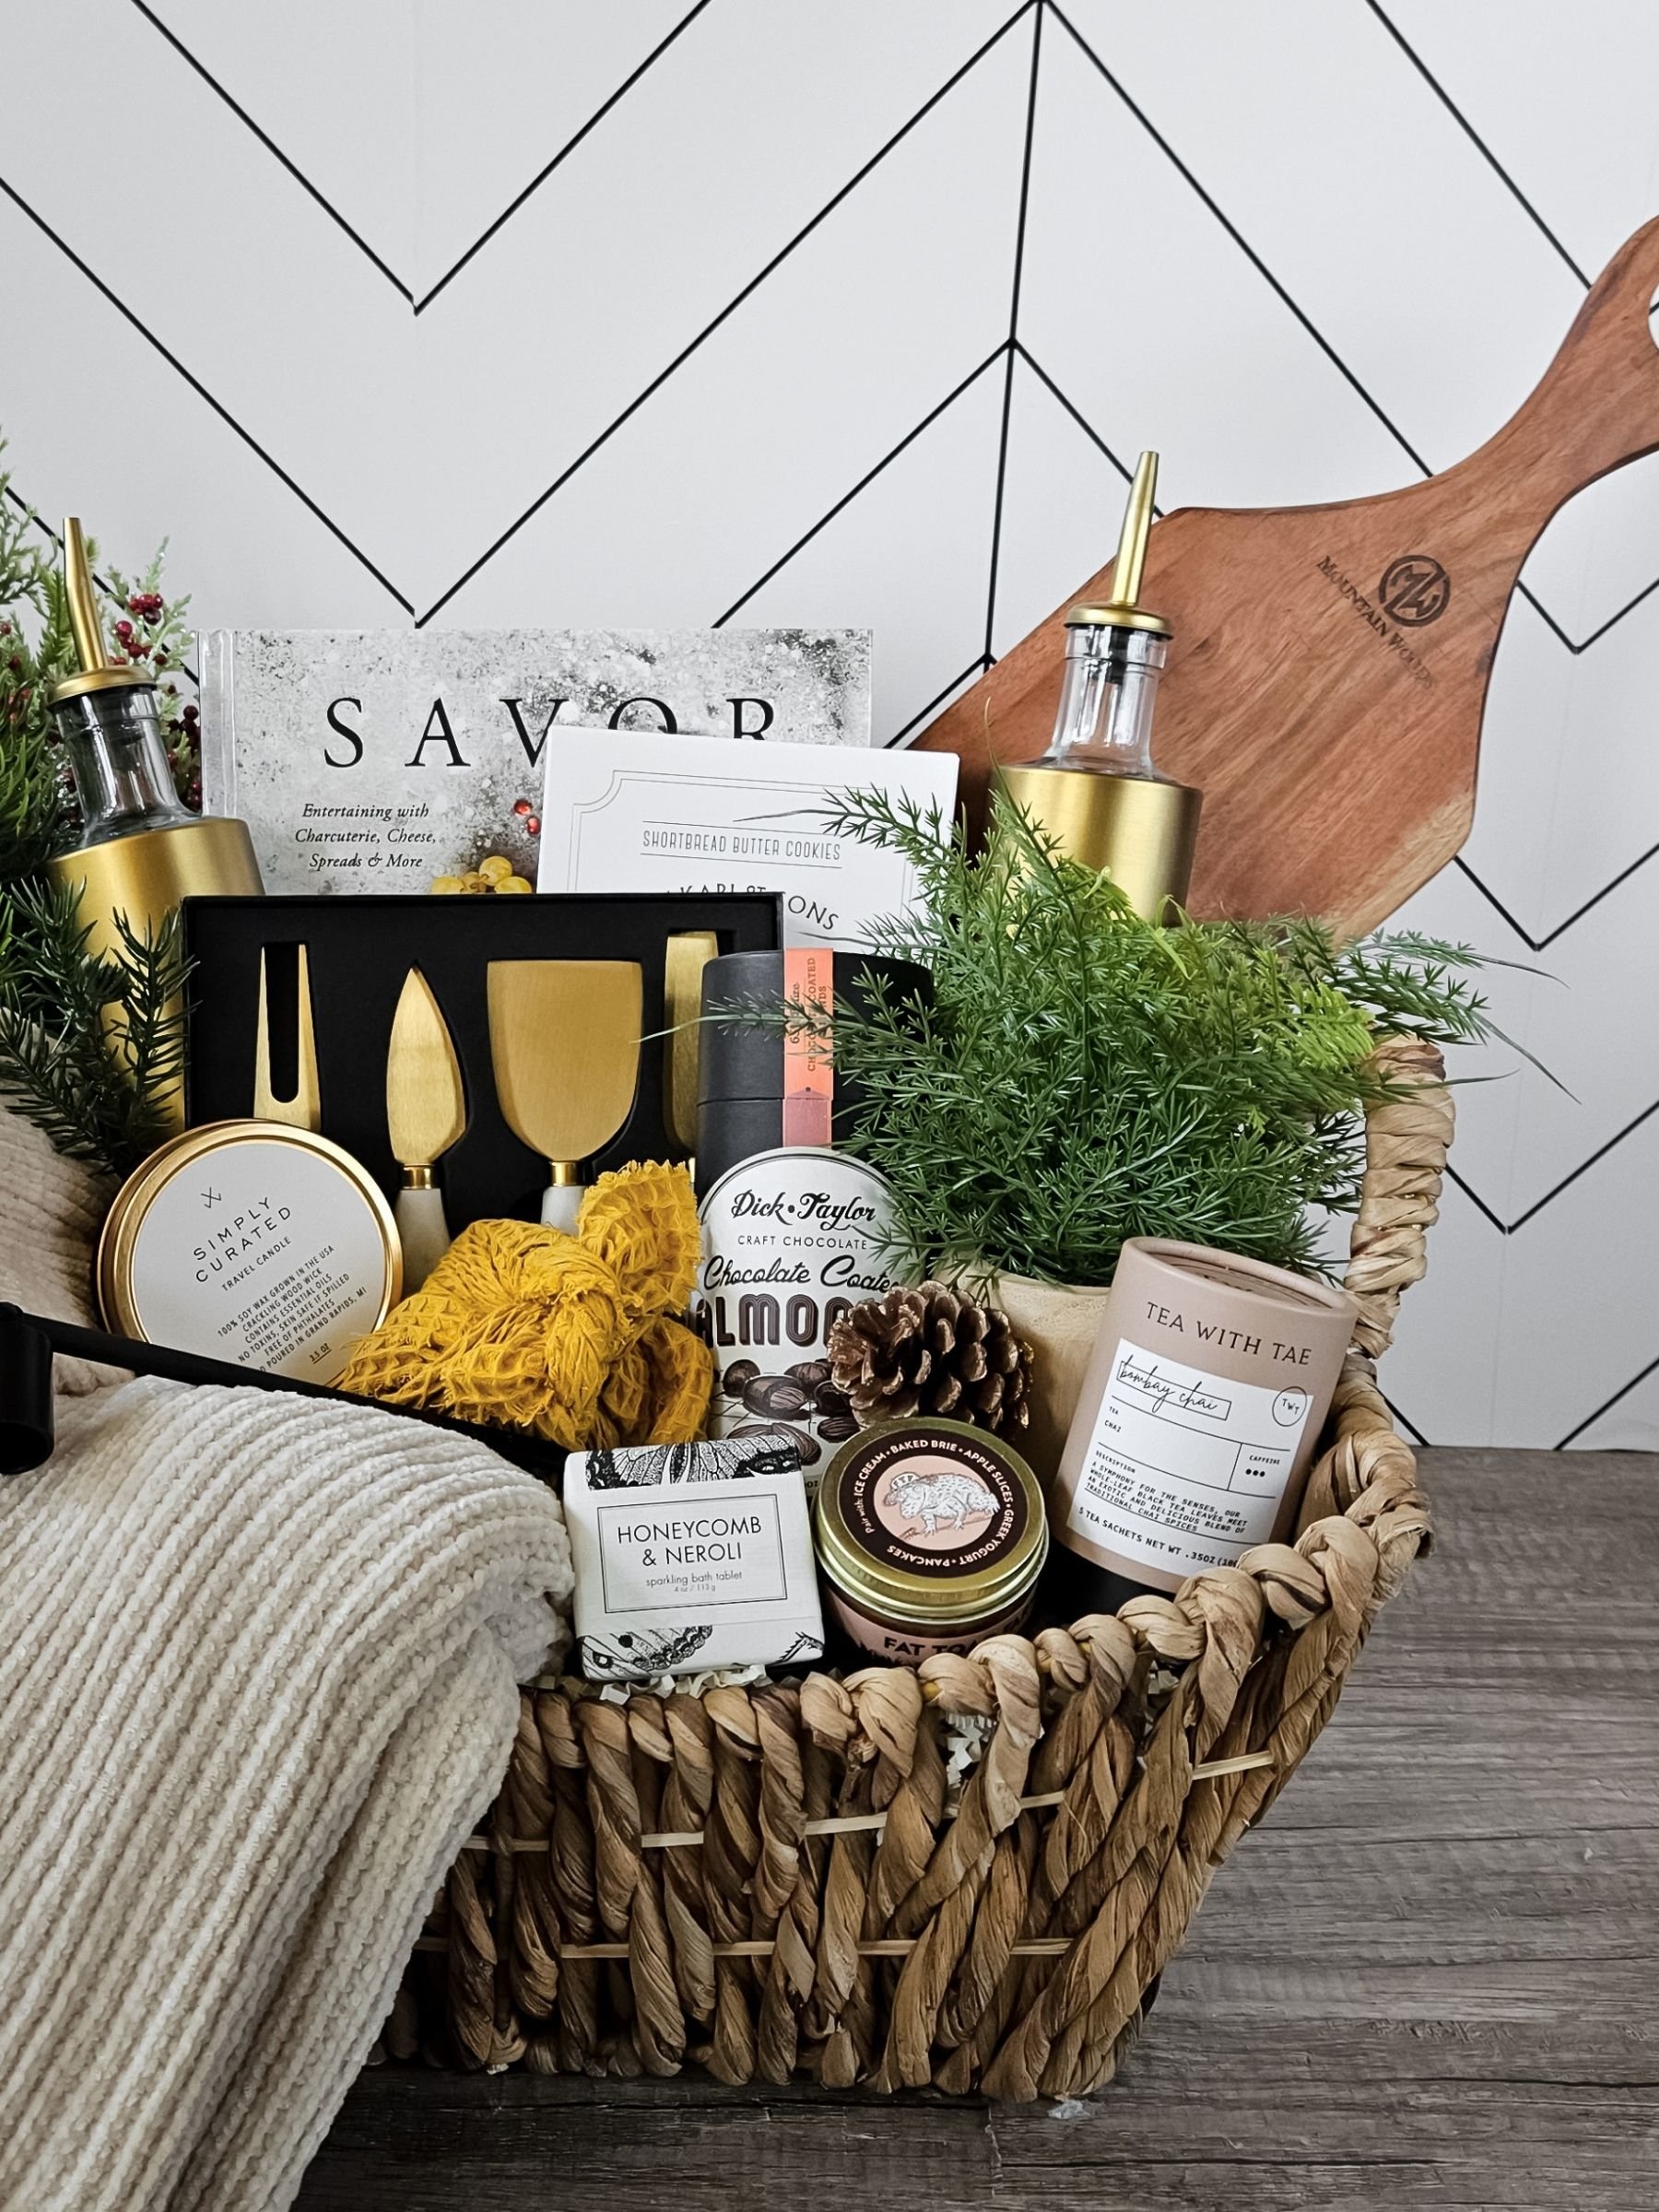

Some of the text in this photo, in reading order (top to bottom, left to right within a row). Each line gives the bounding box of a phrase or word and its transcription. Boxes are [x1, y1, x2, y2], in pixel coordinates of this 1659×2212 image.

[1316, 556, 1432, 689] MOUNTAIN WOODS
[302, 803, 429, 822] Entertaining with
[295, 828, 436, 844] Charcuterie, Cheese,
[643, 830, 841, 860] SHORTBREAD BUTTER COOKIES
[310, 853, 423, 871] Spreads & More
[732, 1190, 876, 1230] Dick Taylor
[194, 1197, 270, 1260] SIMPLY
[737, 1235, 867, 1250] CRAFT CHOCOLATE
[196, 1207, 290, 1282] CURATED
[222, 1236, 291, 1290] TRAVEL CANDLE
[704, 1254, 899, 1293] Chocolate Coate
[218, 1245, 335, 1337] 100% SOY WAX GROWN IN THE USA
[242, 1267, 323, 1332] CRACKLING WOOD WICK
[238, 1274, 349, 1362] NO TOXINS, SKIN SAFE IF SPILLED
[245, 1273, 332, 1344] CONTAINS ESSENTIAL OILS
[265, 1299, 335, 1356] FREE OF PHTHALATES
[266, 1287, 367, 1368] POURED IN GRAND RAPIDS, MI
[1147, 1301, 1312, 1365] TEA WITH TAE
[1120, 1354, 1218, 1413] bombay chai
[1110, 1406, 1119, 1415] TEA
[1282, 1398, 1300, 1415] TWT
[1104, 1419, 1122, 1433] CHAI
[890, 1440, 929, 1453] BAKED
[931, 1440, 958, 1452] BRIE
[1249, 1455, 1280, 1465] CAFFEINE
[858, 1453, 887, 1480] CREAM
[963, 1450, 996, 1473] APPLE
[1096, 1450, 1135, 1473] DESCRIPTION
[853, 1480, 865, 1497] ICE
[992, 1471, 1013, 1502] SLICES
[1090, 1468, 1248, 1527] WHOLE-LEAF BLACK TEA LEAVES MEET
[1100, 1465, 1135, 1486] SYMPHONY
[1139, 1484, 1157, 1493] FOR
[1161, 1491, 1177, 1501] THE
[1182, 1499, 1218, 1514] SENSES,
[1225, 1510, 1241, 1518] OUR
[1087, 1483, 1198, 1532] TRADITIONAL CHAI SPICES
[1099, 1481, 1126, 1499] EXOTIC
[1130, 1497, 1147, 1506] AND
[1150, 1504, 1200, 1524] DELICIOUS
[1205, 1521, 1231, 1532] BLEND
[618, 1516, 762, 1544] HONEYCOMB
[862, 1517, 875, 1534] Pair
[995, 1509, 1014, 1540] GREEK
[1086, 1510, 1100, 1524] TEA
[1102, 1520, 1142, 1543] SACHETS
[1146, 1537, 1166, 1550] NET
[1168, 1546, 1182, 1556] WT
[641, 1542, 743, 1567] & NEROLI
[887, 1546, 950, 1567] PANCAKES
[959, 1539, 1001, 1565] YOGURT
[645, 1570, 742, 1588] sparkling bath tablet
[884, 1637, 925, 1656] FAT
